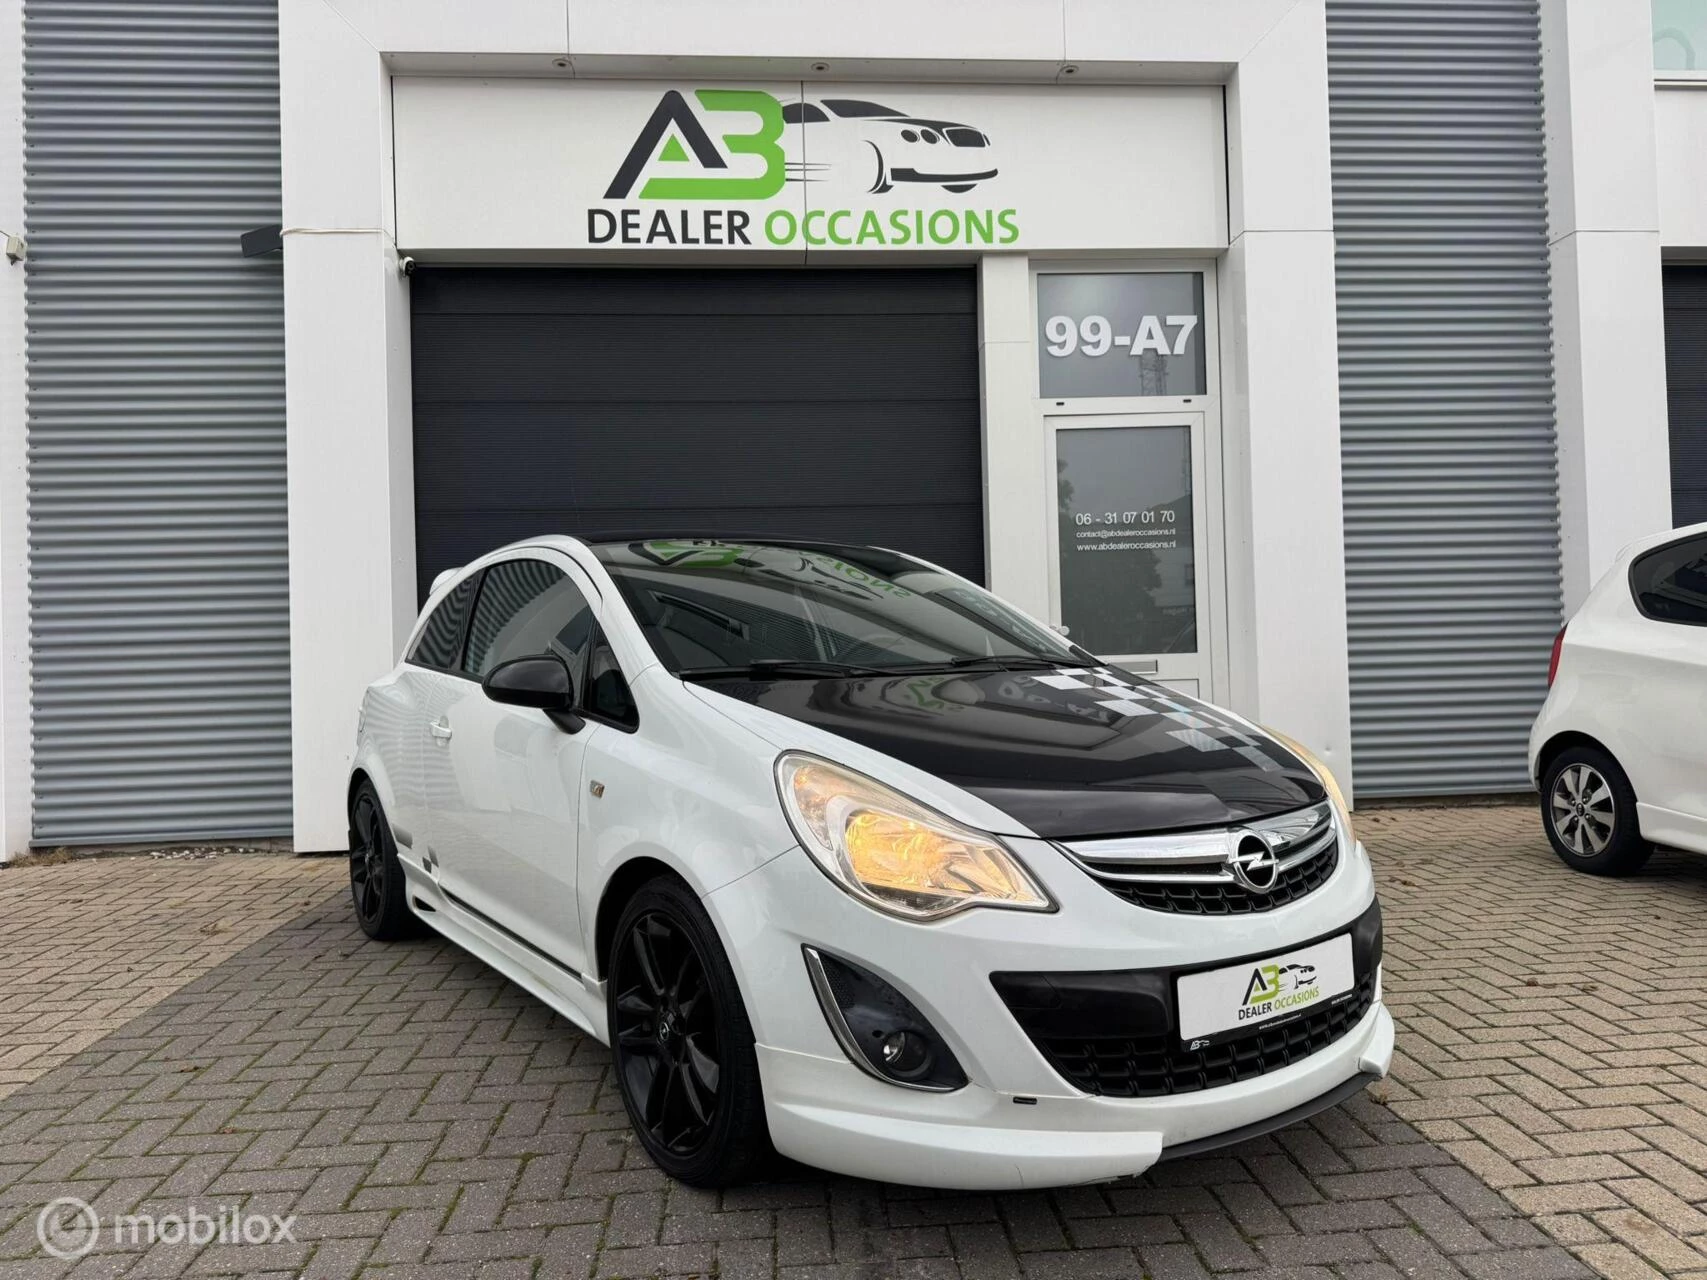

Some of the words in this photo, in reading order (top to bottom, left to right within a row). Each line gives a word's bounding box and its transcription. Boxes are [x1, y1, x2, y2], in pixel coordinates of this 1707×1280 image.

[602, 89, 786, 200] AB
[587, 208, 752, 245] DEALER
[764, 208, 1020, 246] OCCASIONS
[1045, 314, 1198, 357] 99-A7
[1075, 512, 1092, 526] 06
[1104, 511, 1118, 525] 31
[1122, 511, 1137, 524] 07
[1141, 510, 1155, 524] 01
[1160, 510, 1176, 523] 70
[1076, 528, 1176, 538] contact@abdealeroccasions.nl
[1076, 540, 1177, 551] www.abdealeroccasions.nl
[1242, 964, 1280, 1006] AB
[1238, 1001, 1272, 1021] DEALER
[1274, 986, 1320, 1011] OCCASIONS
